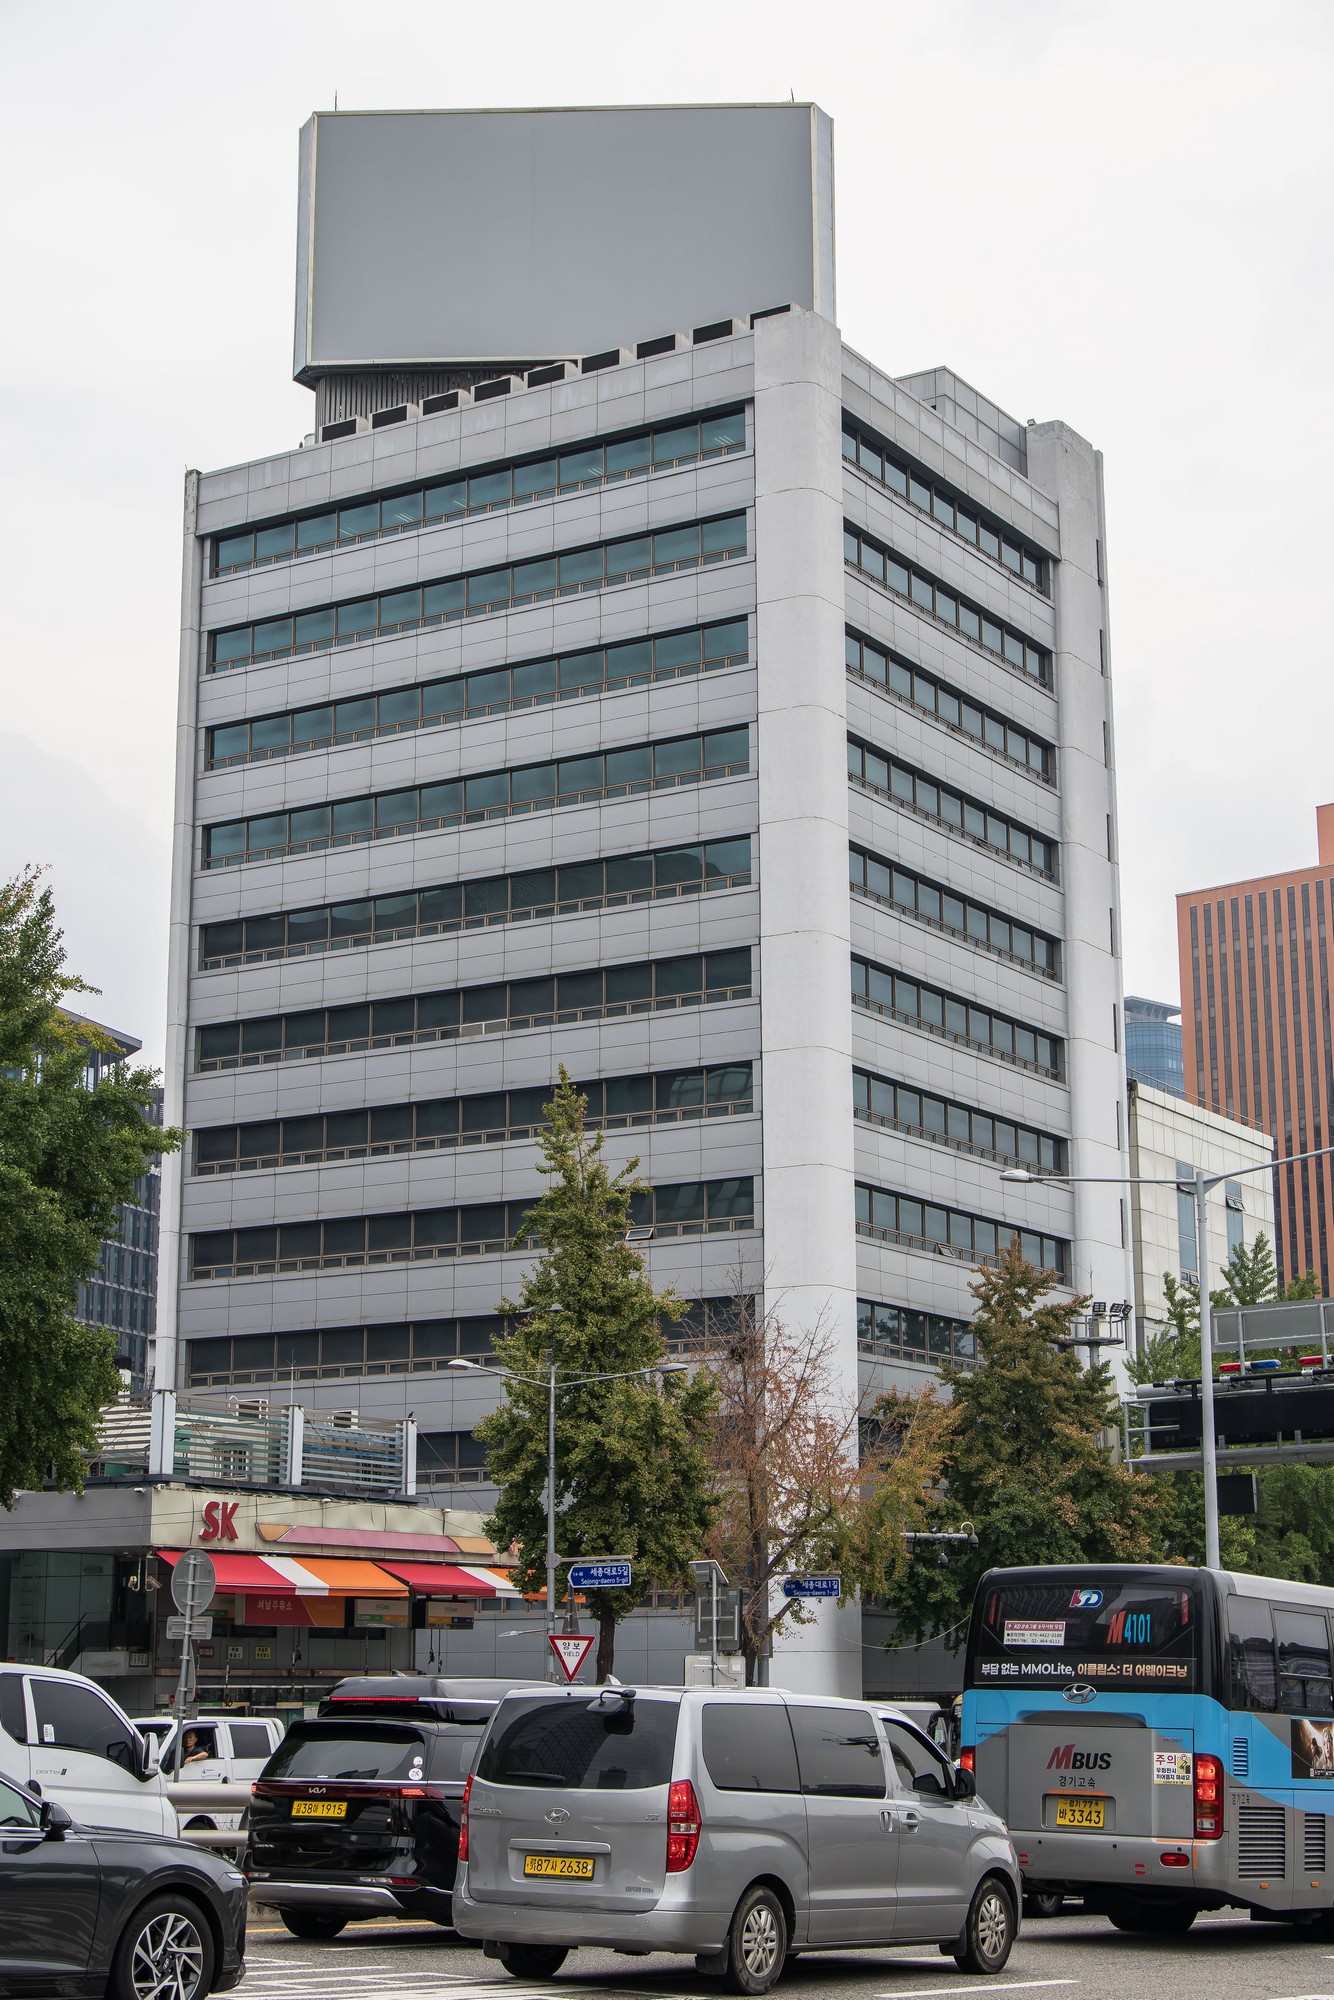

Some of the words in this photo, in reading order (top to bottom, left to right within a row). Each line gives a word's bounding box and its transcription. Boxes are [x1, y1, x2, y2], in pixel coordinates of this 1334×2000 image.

[199, 1500, 240, 1540] SK
[589, 1565, 628, 1577] 세종대로5길
[616, 1576, 628, 1584] 5-gil
[801, 1580, 838, 1589] 세종대로1길
[257, 1599, 293, 1611] 서남주유소
[981, 1663, 999, 1675] 부담
[1001, 1663, 1019, 1675] 없는
[1021, 1662, 1075, 1676] MMOLite,
[1077, 1663, 1121, 1676] 이클립스:
[1122, 1663, 1133, 1676] 더
[1135, 1664, 1188, 1677] 어웨이크닝
[1155, 1754, 1177, 1766] 주의
[1059, 1775, 1096, 1789] 경기고속
[320, 1803, 343, 1815] 1915
[559, 1859, 589, 1875] 2638
